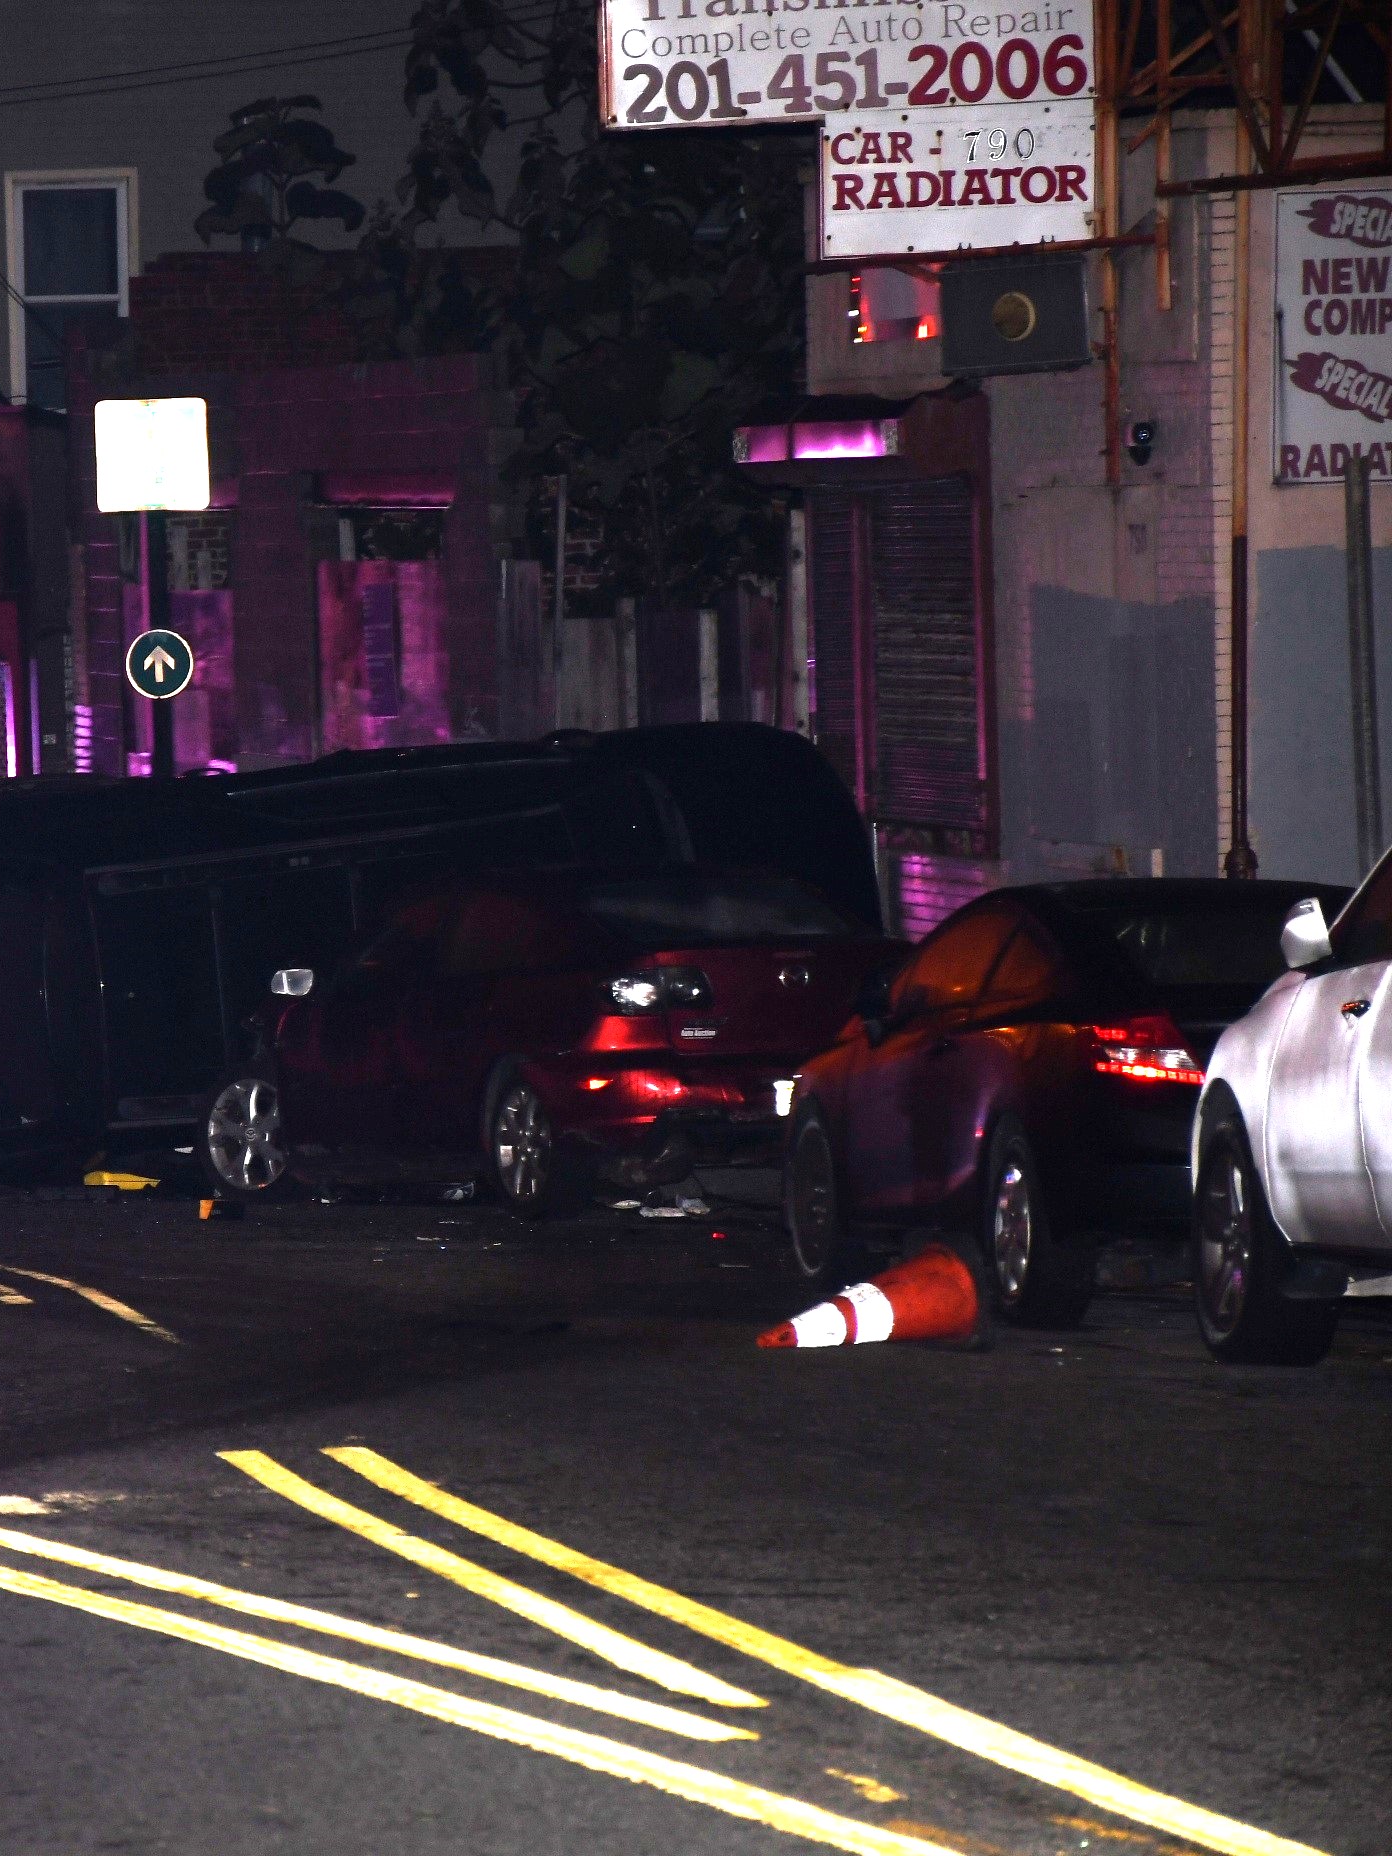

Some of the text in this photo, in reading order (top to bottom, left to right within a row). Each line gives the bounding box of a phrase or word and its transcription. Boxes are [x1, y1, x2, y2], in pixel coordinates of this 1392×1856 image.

[621, 3, 1073, 58] Complete Auto Repair
[622, 34, 1088, 123] 201-451-2006
[830, 131, 914, 165] CAR
[962, 127, 1036, 164] 790
[831, 164, 1088, 211] RADIATOR
[1301, 255, 1391, 296] NEW
